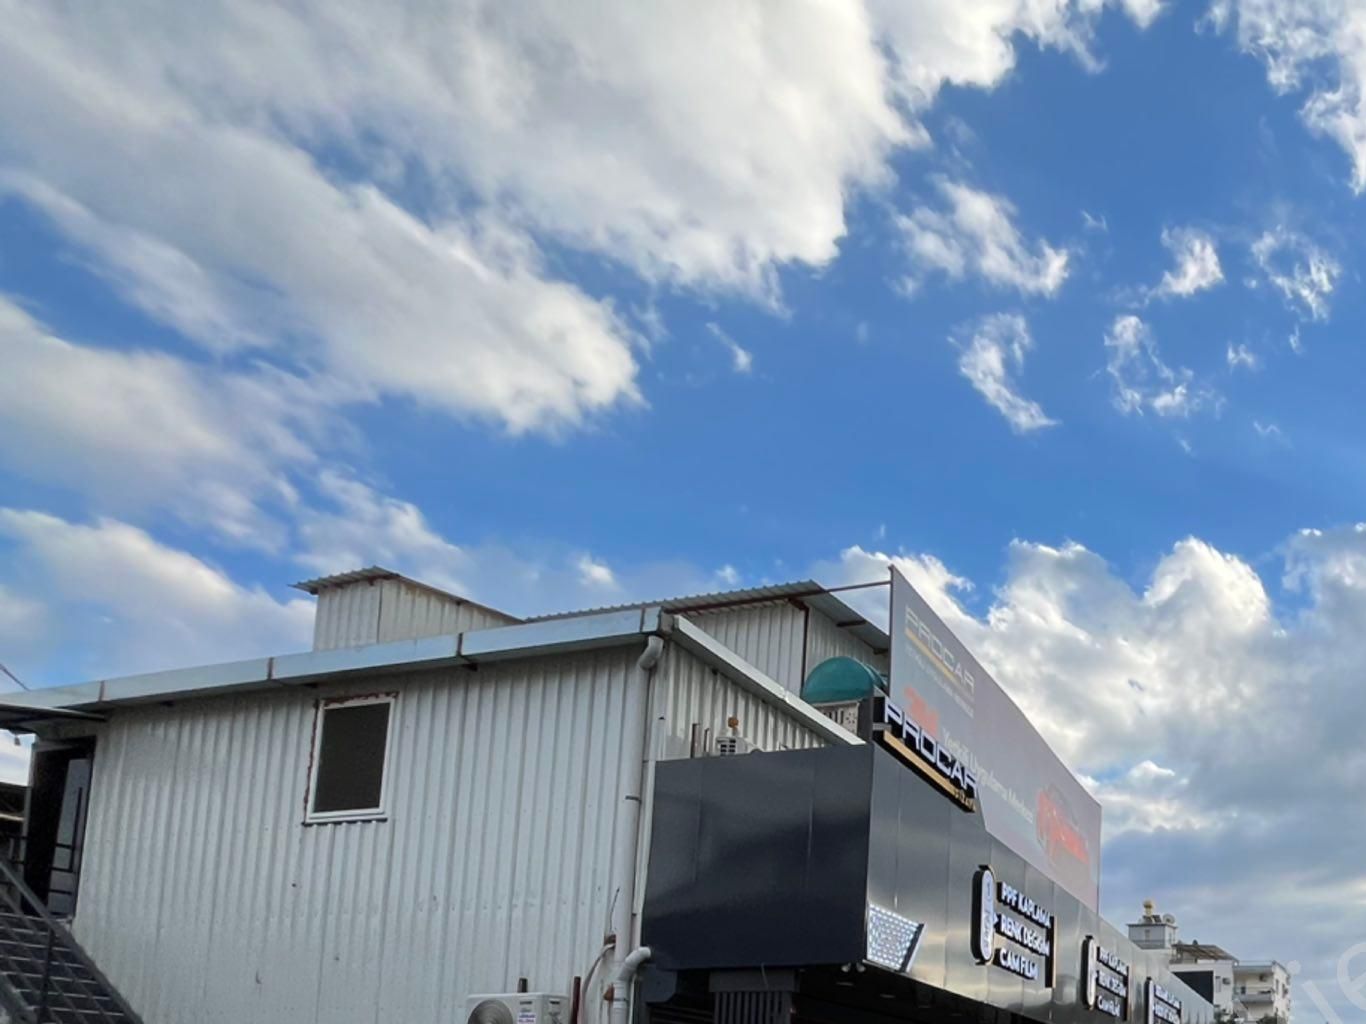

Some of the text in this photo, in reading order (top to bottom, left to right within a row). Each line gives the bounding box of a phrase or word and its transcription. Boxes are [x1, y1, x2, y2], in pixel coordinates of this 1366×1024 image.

[885, 697, 977, 798] PROCAR
[1002, 882, 1018, 907] PPF
[1001, 914, 1022, 942] RENK
[1000, 947, 1020, 973] CAM
